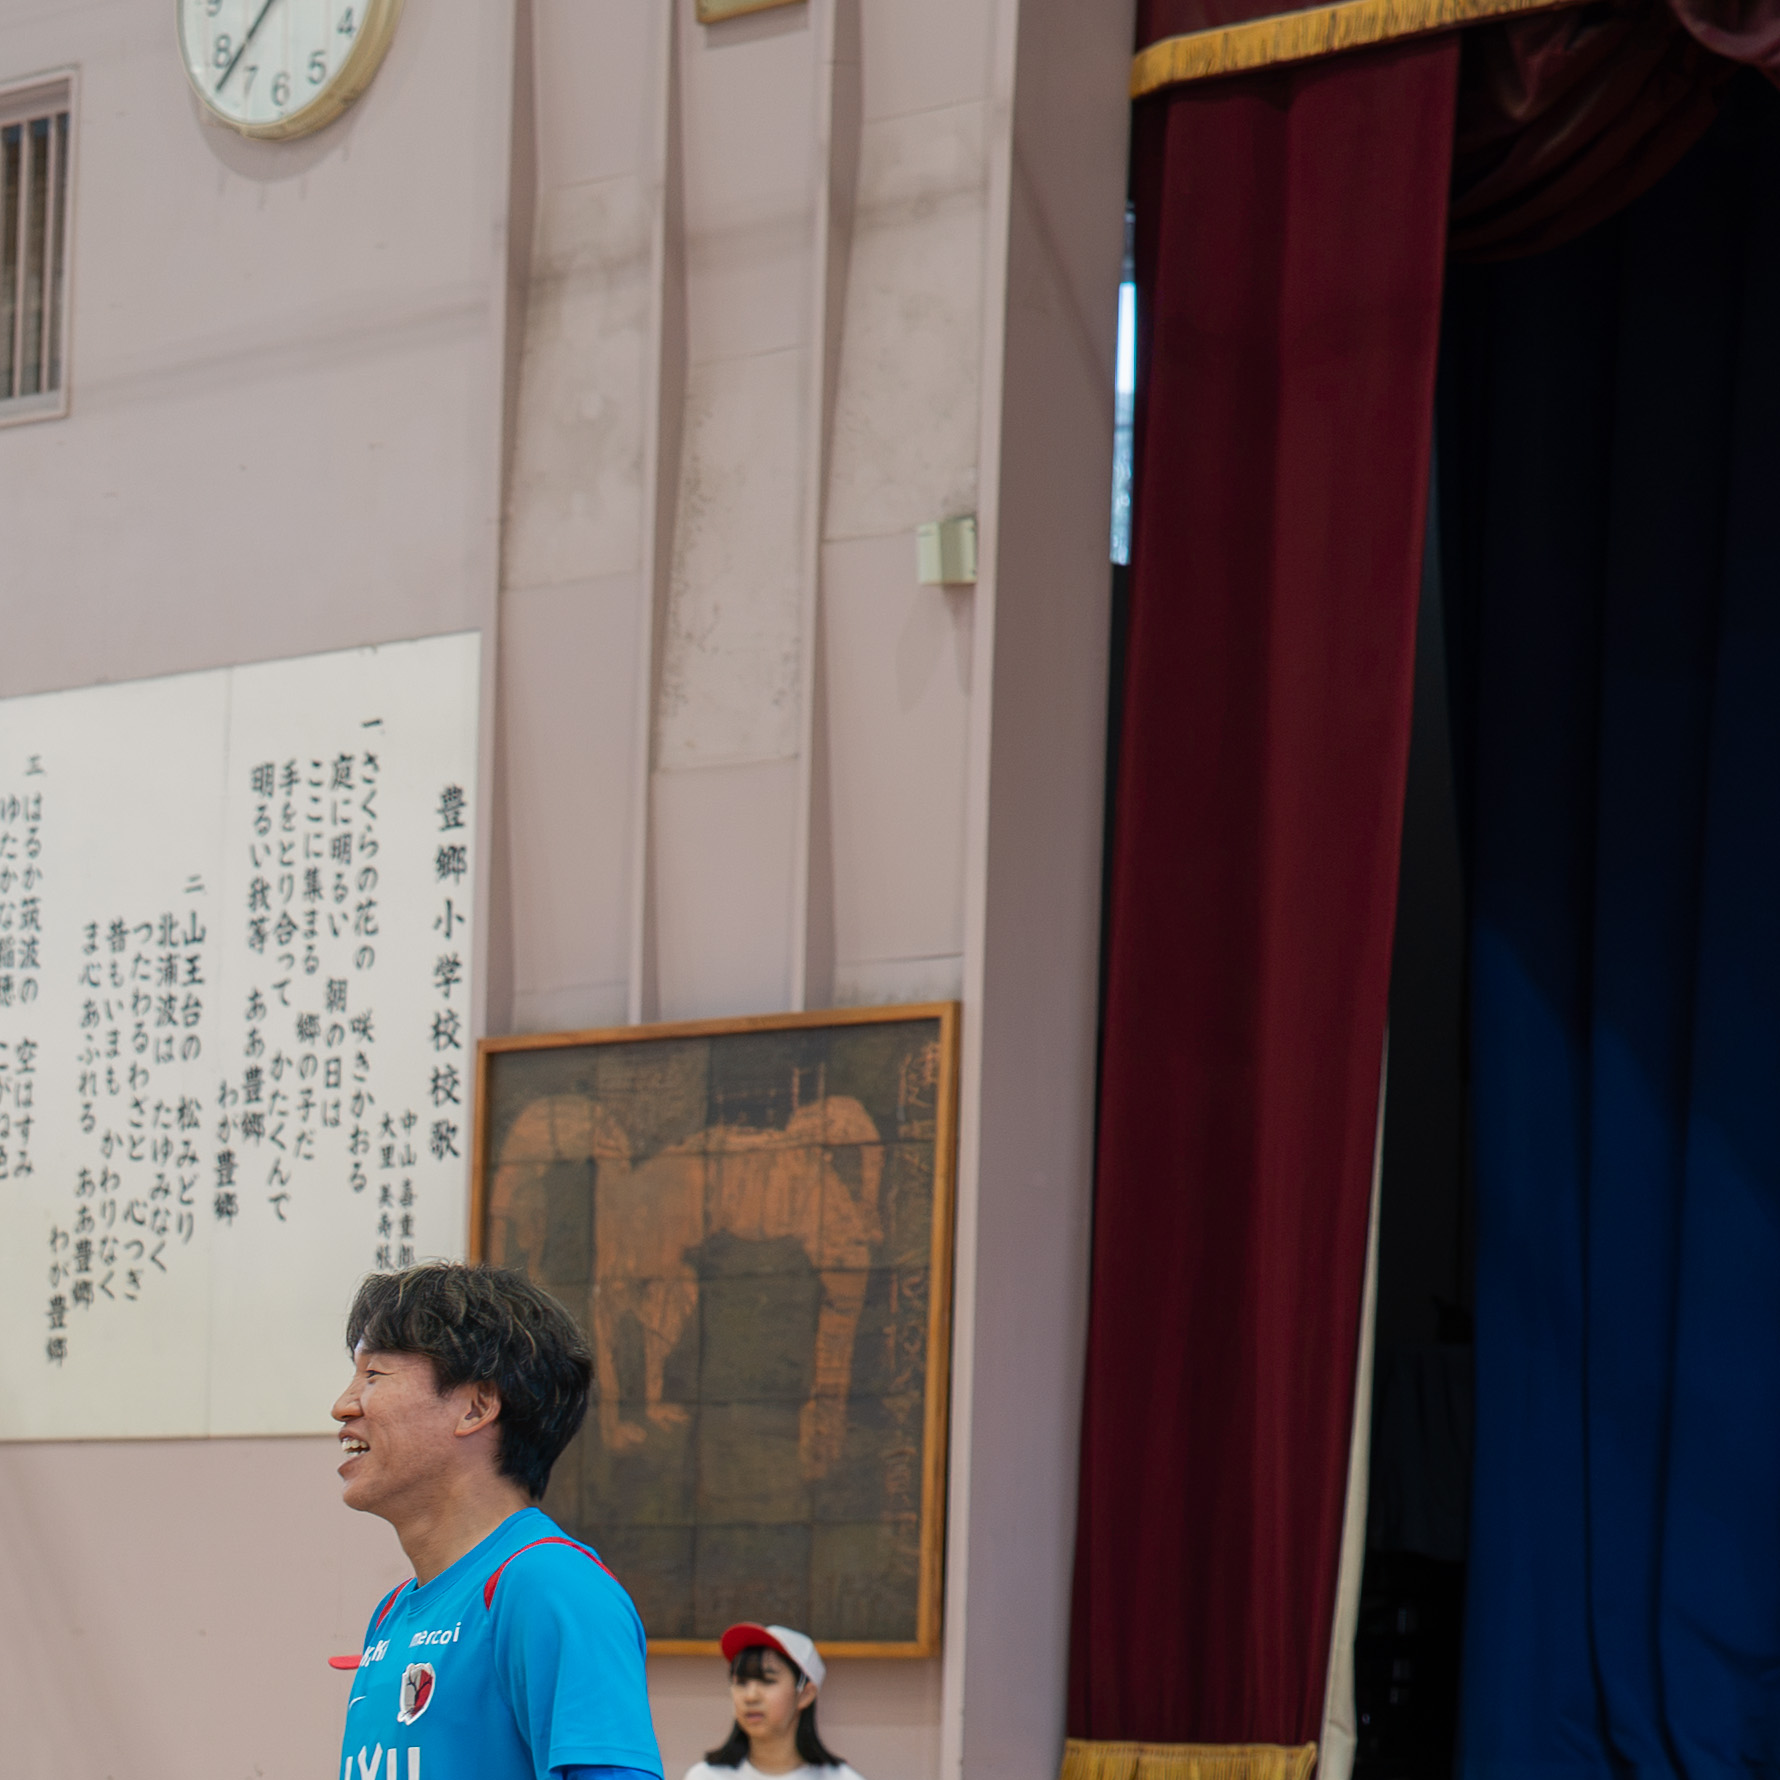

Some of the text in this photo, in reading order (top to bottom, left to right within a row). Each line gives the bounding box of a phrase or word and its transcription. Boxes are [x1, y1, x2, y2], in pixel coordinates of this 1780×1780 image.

[213, 34, 231, 69] 8
[271, 72, 290, 106] 6
[307, 50, 325, 85] 5
[303, 760, 323, 975] ここに集まる
[328, 753, 354, 938] 庭に明るい
[354, 752, 379, 969] さくらの花の
[430, 784, 470, 1164] 豊郷小学校校歌
[241, 988, 266, 1144] ああ豊郷
[213, 1081, 238, 1224] わが豊郷
[46, 1227, 69, 1366] わが豊郷
[72, 1168, 95, 1309] ああ豊郷
